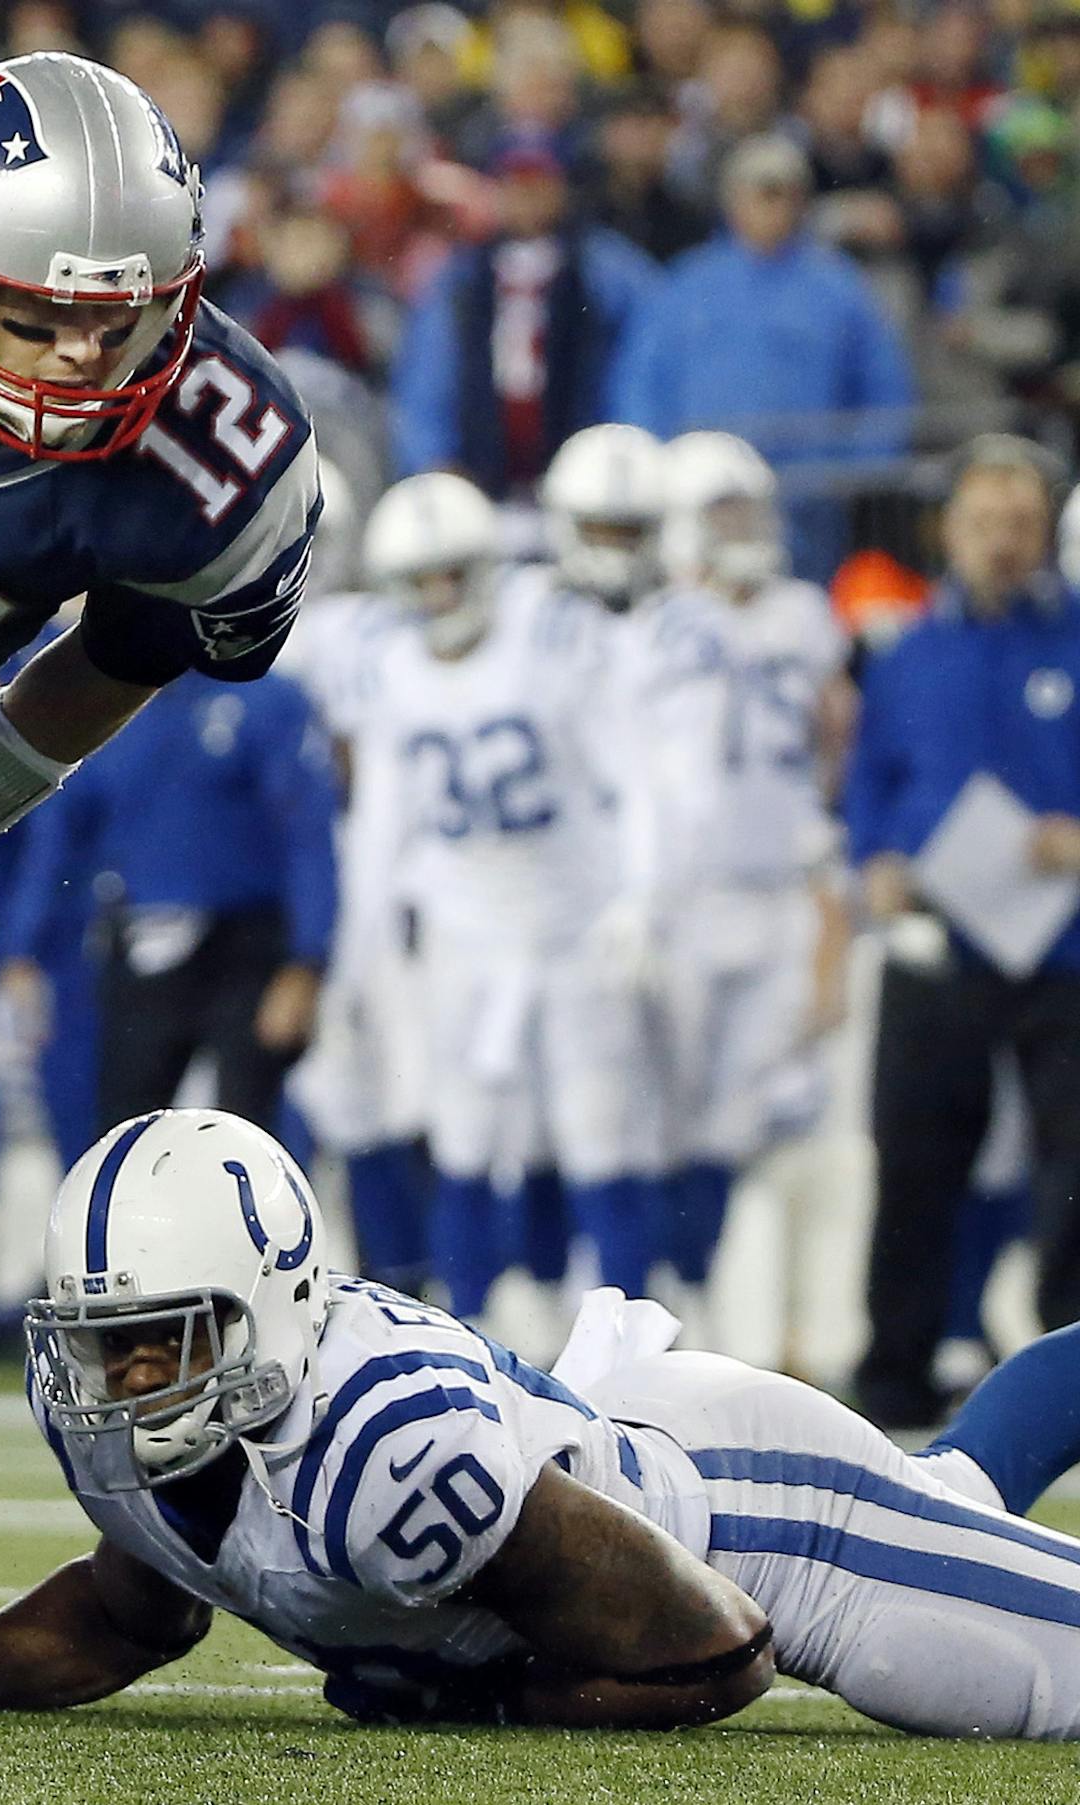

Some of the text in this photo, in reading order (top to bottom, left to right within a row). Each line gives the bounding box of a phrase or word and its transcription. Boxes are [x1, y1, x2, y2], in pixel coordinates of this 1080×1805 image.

[128, 353, 294, 527] 12
[406, 714, 560, 838] 32
[377, 1453, 505, 1585] 50
